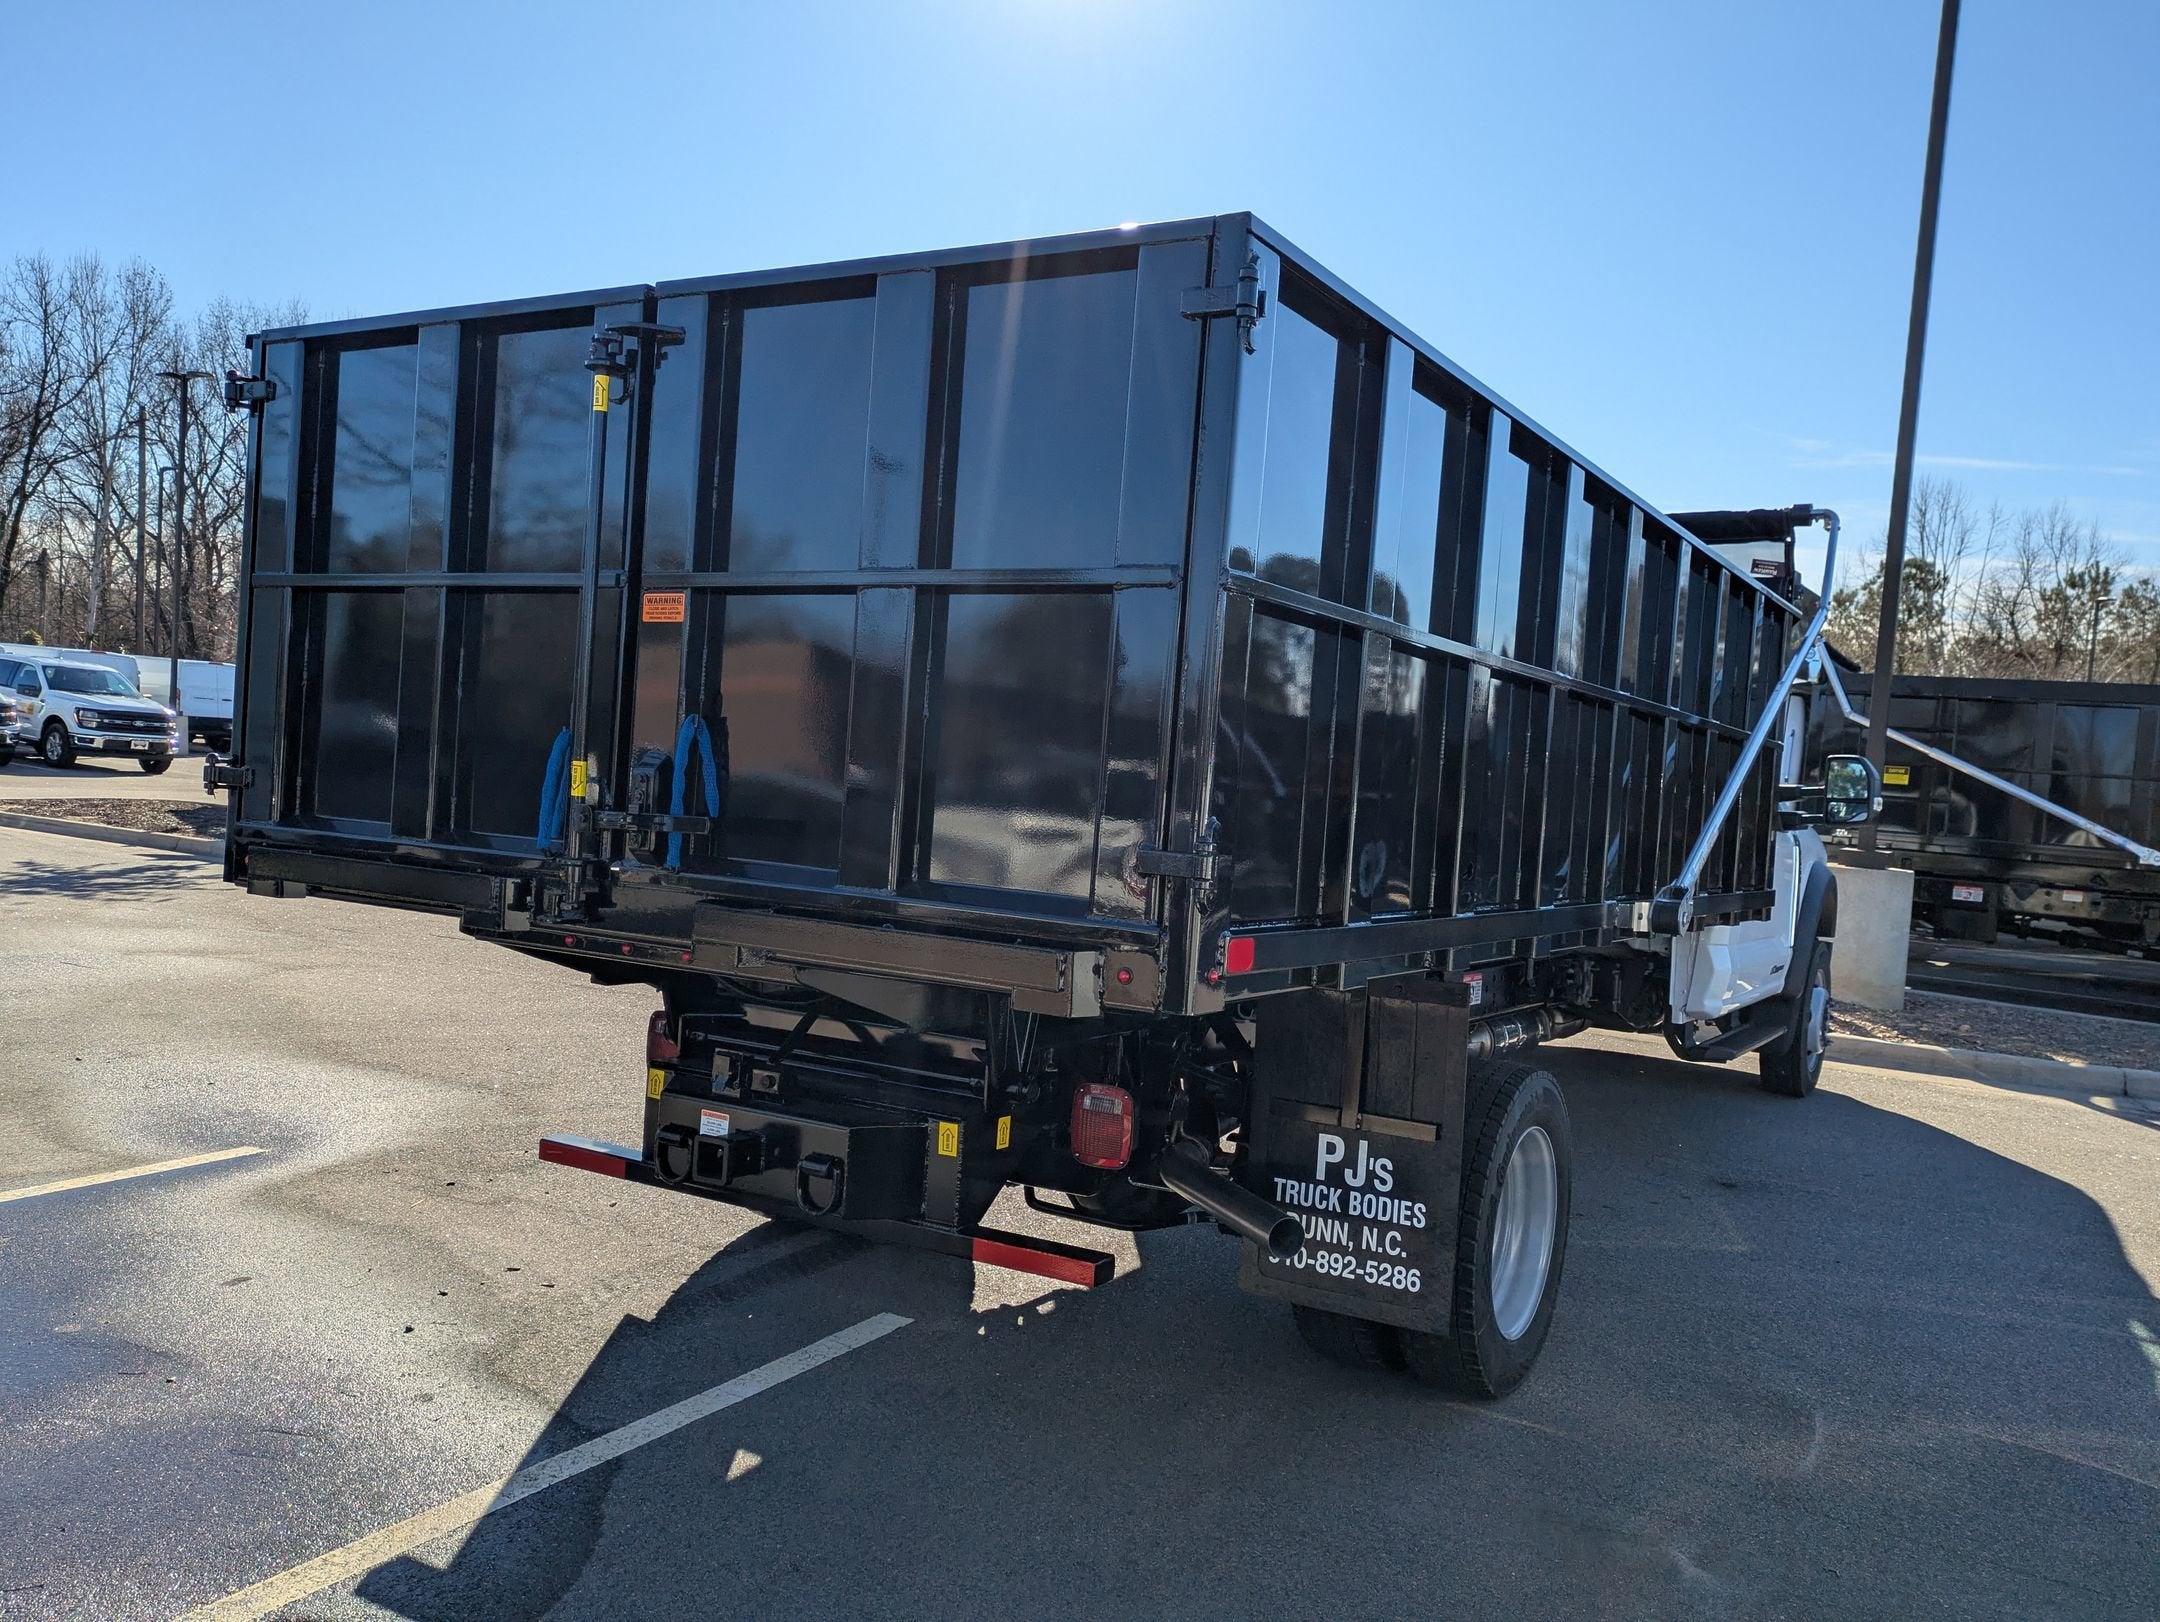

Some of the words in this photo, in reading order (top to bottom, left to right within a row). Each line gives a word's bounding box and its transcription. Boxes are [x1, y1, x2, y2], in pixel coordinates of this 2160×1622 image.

[1274, 1177, 1342, 1213] TRUCK
[1349, 1191, 1426, 1229] BODIES
[1361, 1225, 1407, 1258] N.C.
[1268, 1246, 1421, 1293] 0-892-5286
